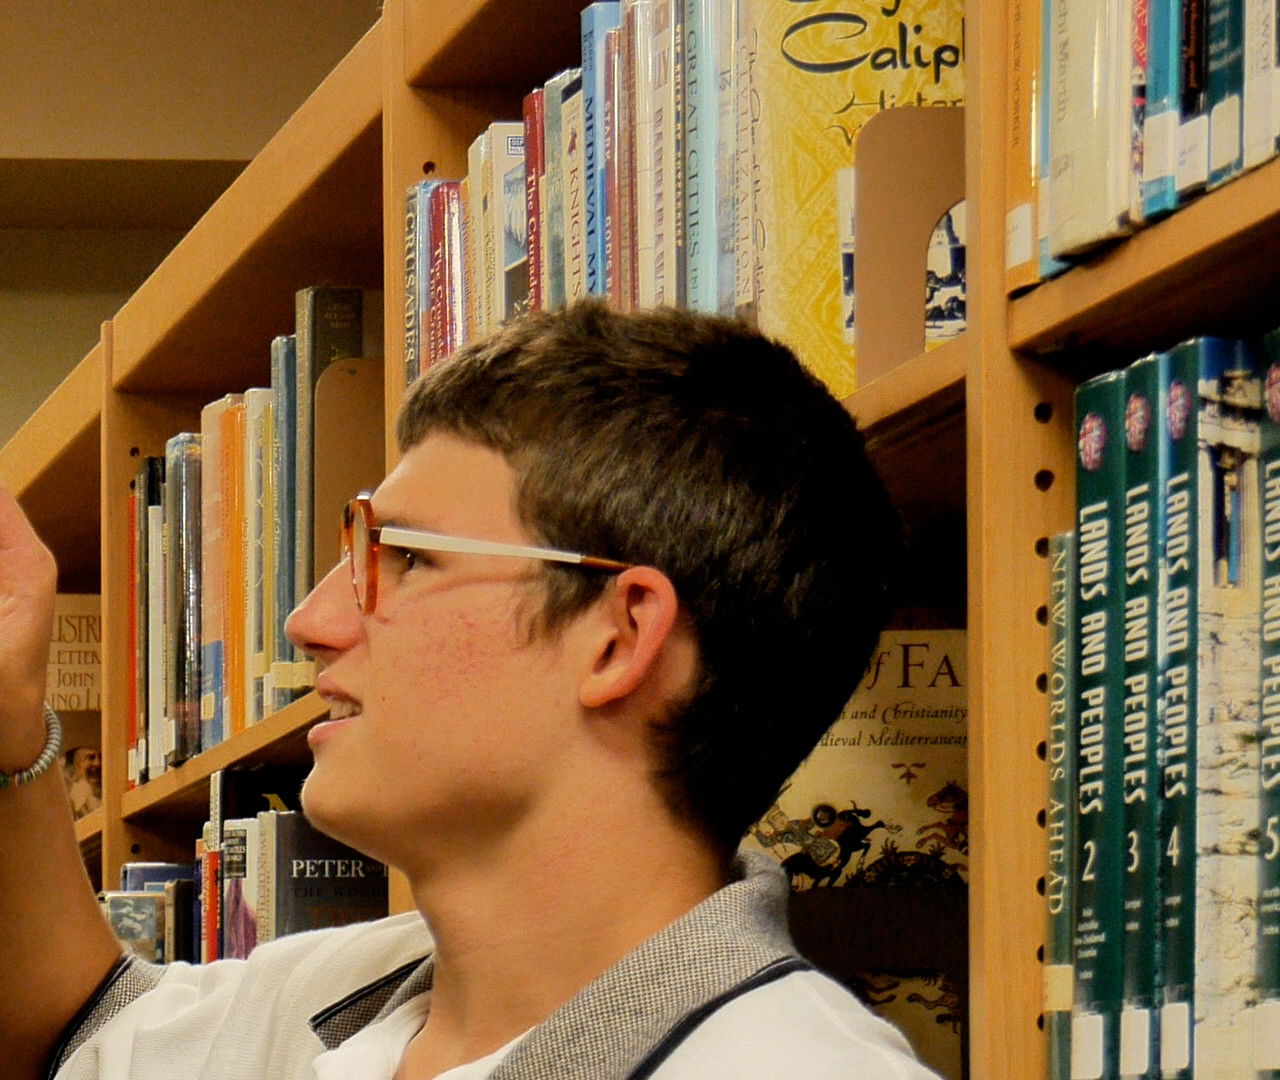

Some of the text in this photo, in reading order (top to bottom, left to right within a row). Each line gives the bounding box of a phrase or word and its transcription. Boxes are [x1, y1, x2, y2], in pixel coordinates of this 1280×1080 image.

[686, 31, 700, 141] GREAT
[780, 11, 964, 84] Calip
[585, 97, 596, 243] MEDIEVAL
[686, 149, 700, 260] CITIES
[740, 45, 750, 298] CIVILIZATION
[404, 212, 417, 363] CRUSADES
[525, 168, 537, 309] The Crusades
[569, 167, 582, 298] KNIGHTS
[57, 668, 95, 687] JOHN
[850, 702, 968, 725] and Christianity
[896, 643, 962, 689] FA
[1079, 500, 1109, 883] LANDS AND PEOPLES 2
[1123, 483, 1150, 873] LANDS AND PEOPLES 3
[1164, 472, 1190, 867] LANDS AND PEOPLES 4
[819, 732, 862, 747] dieval
[1048, 549, 1067, 915] NEW WORLDS AHEAD
[290, 859, 365, 878] PETER
[1264, 816, 1280, 861] 5
